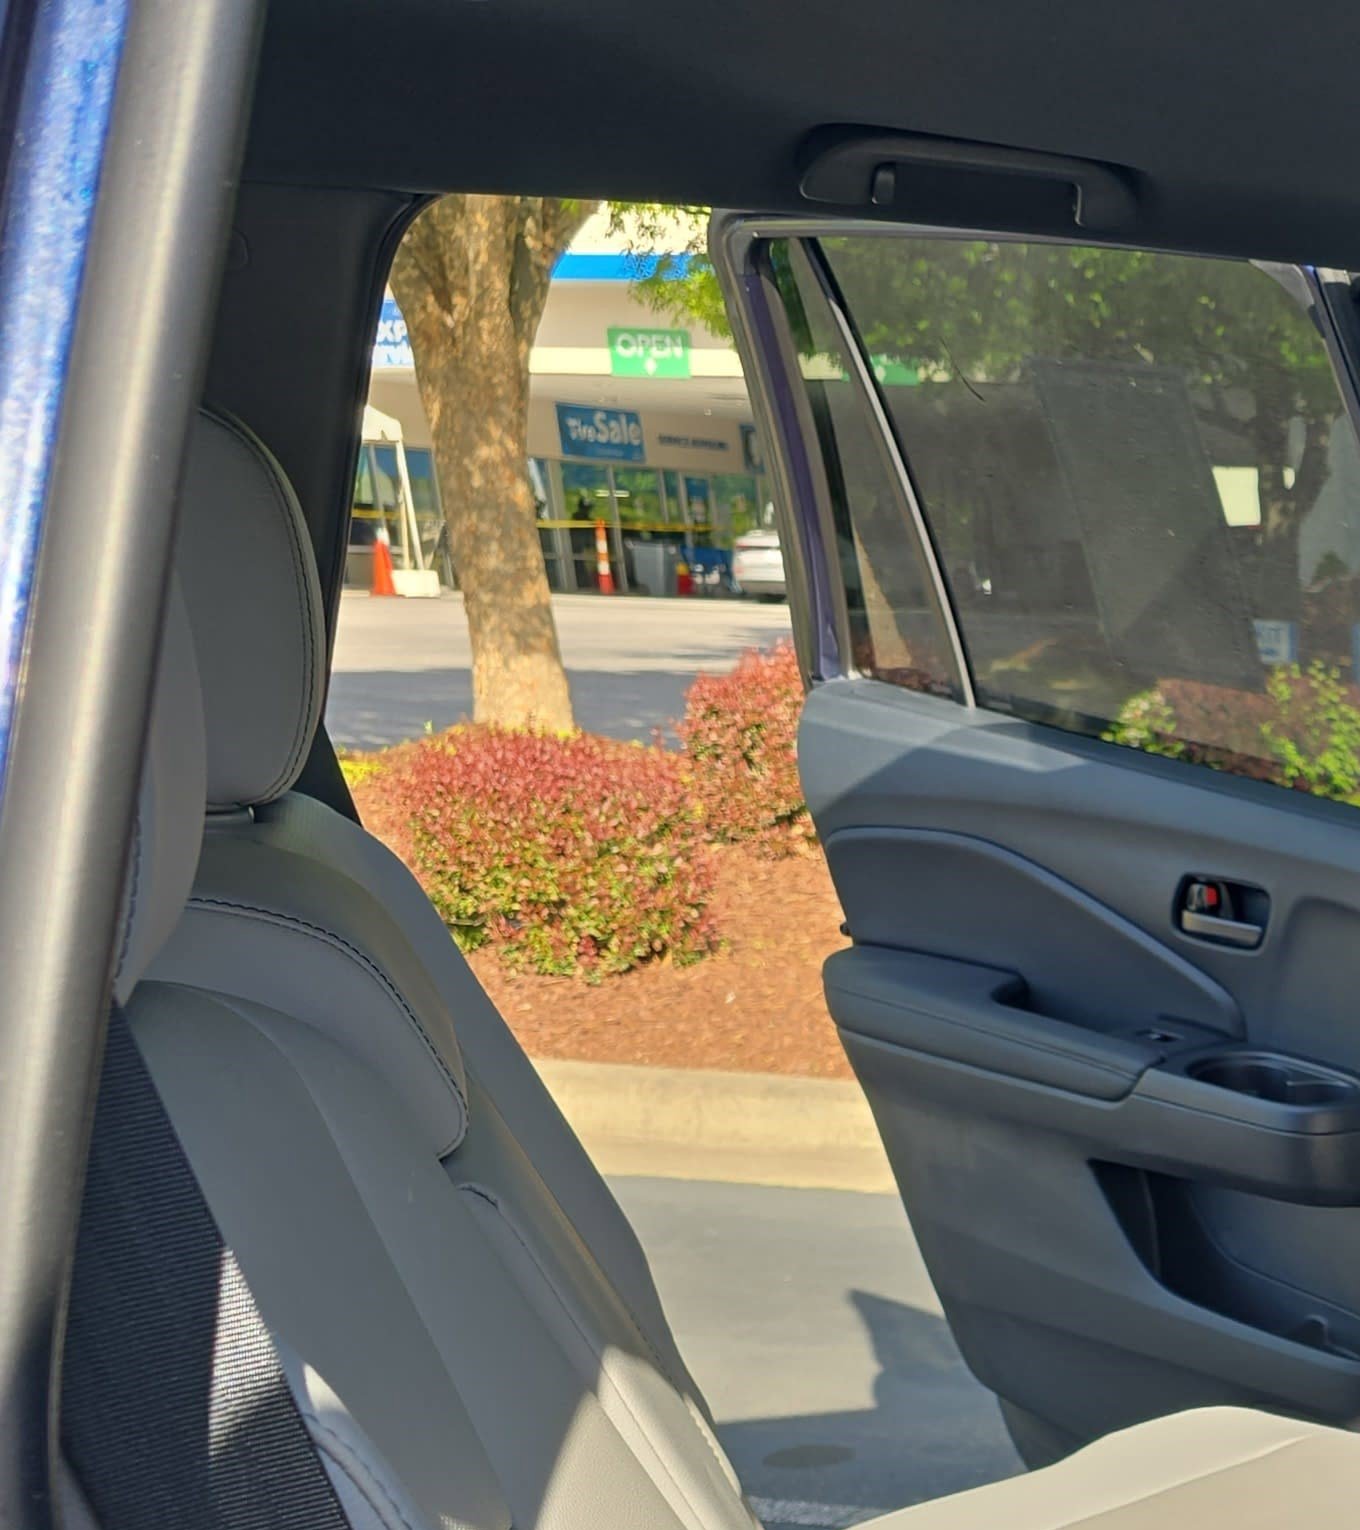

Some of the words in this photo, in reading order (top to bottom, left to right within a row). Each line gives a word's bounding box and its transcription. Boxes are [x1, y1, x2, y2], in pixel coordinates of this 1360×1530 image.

[616, 333, 684, 358] OPEN
[565, 416, 595, 443] Tire
[593, 411, 642, 445] Sale
